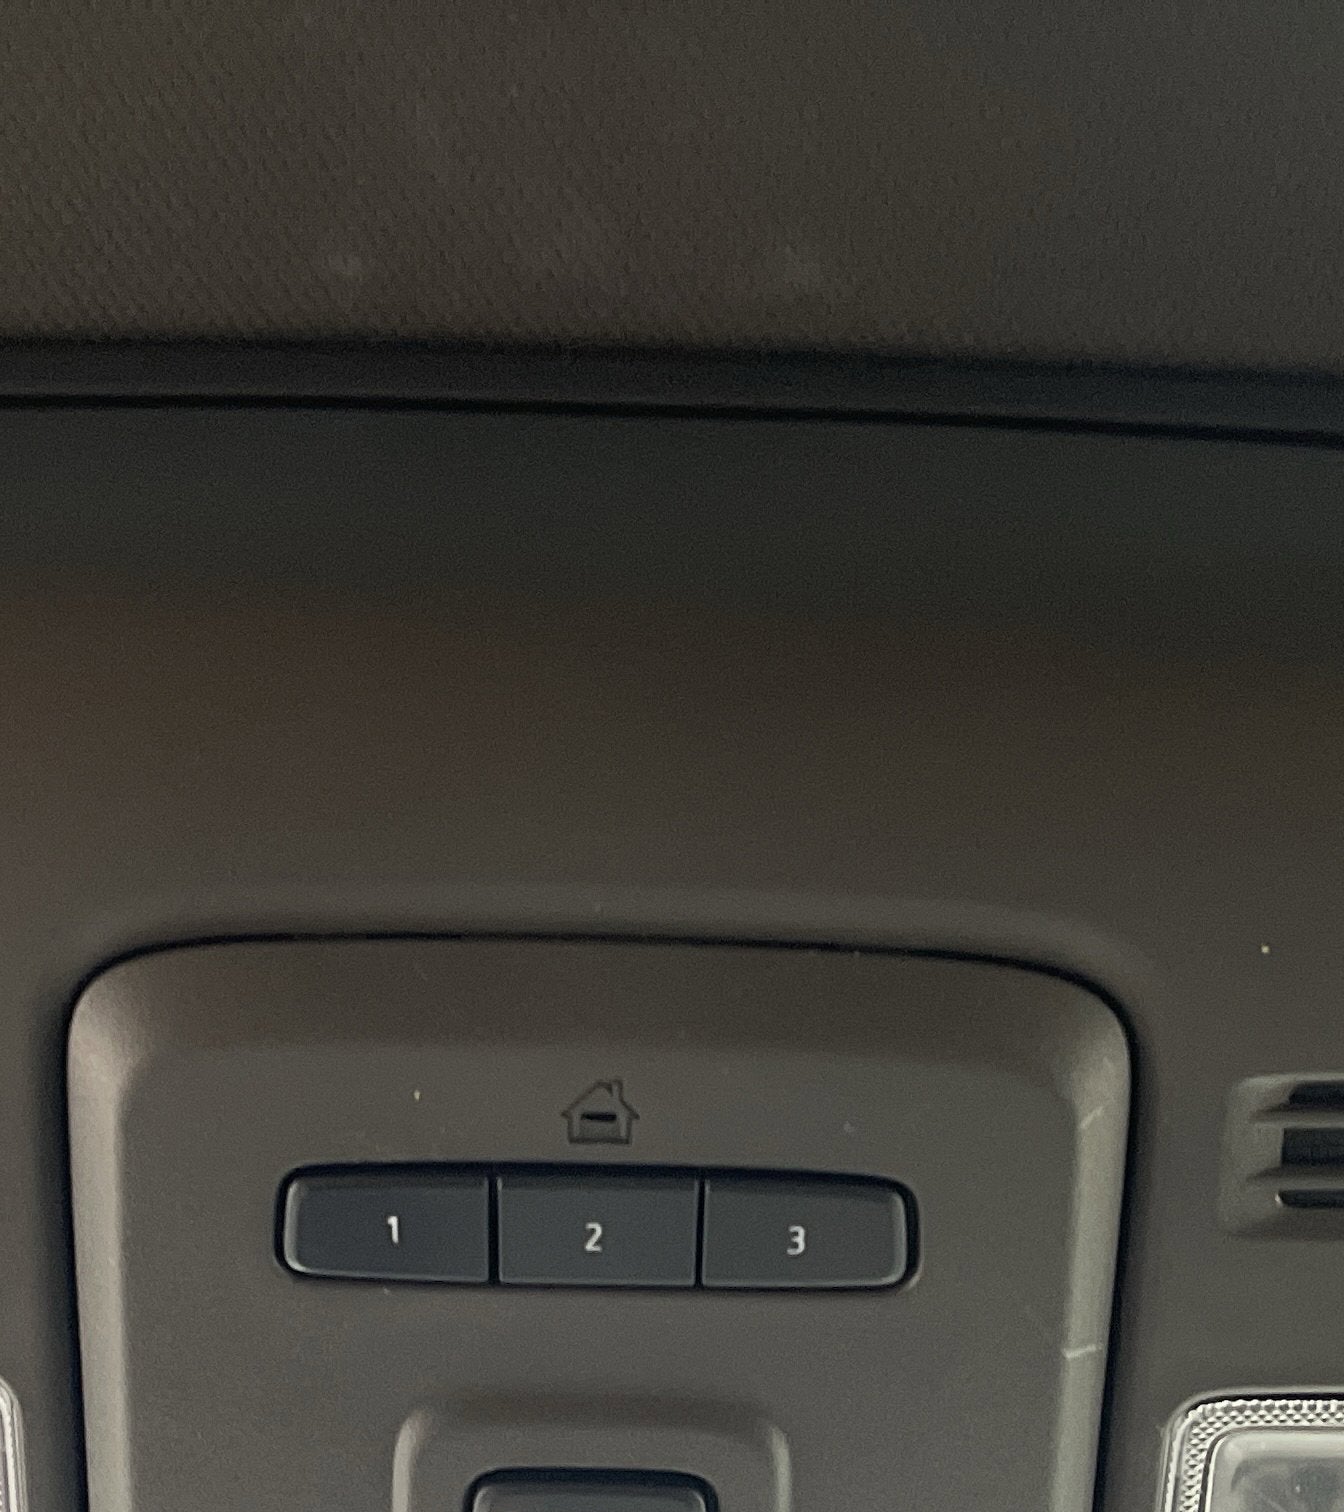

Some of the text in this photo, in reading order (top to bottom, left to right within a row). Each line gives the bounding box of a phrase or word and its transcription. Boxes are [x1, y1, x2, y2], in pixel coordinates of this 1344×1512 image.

[387, 1216, 400, 1243] 1
[585, 1223, 603, 1252] 2
[787, 1226, 807, 1255] 3
